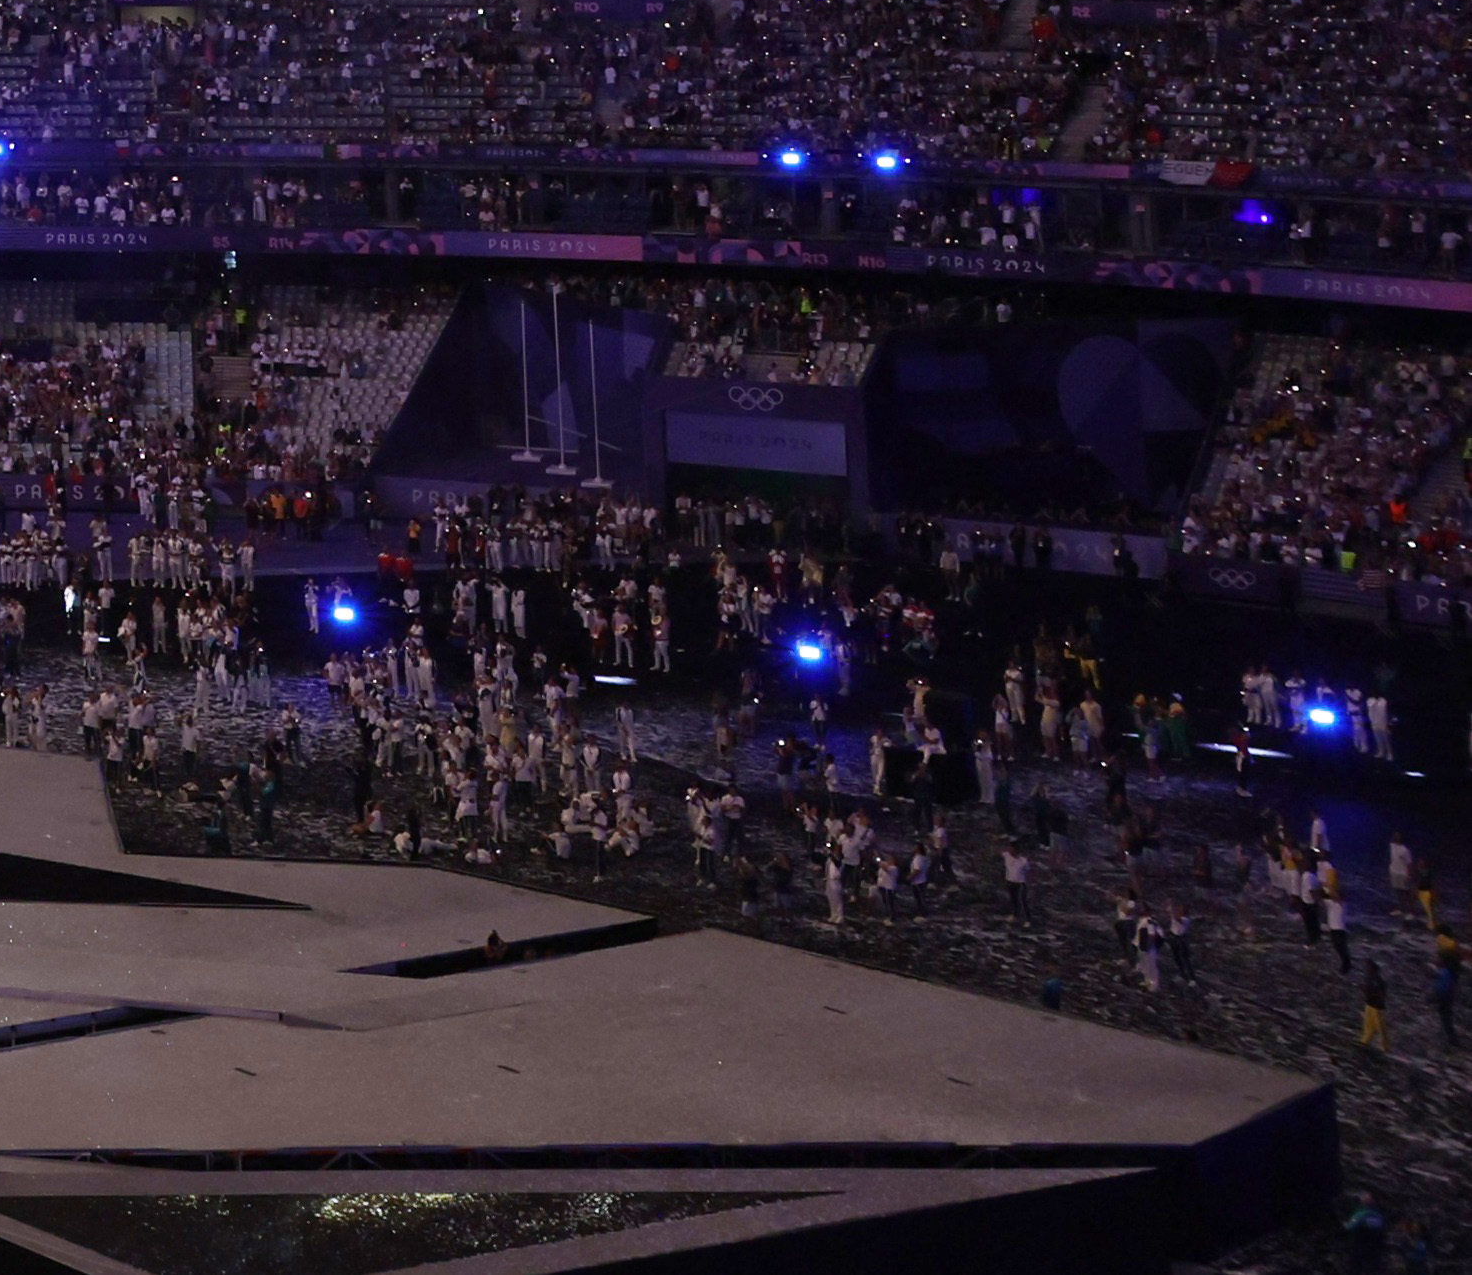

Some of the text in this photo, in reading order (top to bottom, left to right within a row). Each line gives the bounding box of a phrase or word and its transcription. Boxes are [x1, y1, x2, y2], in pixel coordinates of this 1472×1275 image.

[574, 2, 599, 12] R10
[646, 2, 664, 13] R9
[1072, 6, 1091, 18] R2
[46, 232, 148, 245] PARIS 2024
[213, 235, 231, 248] S5
[268, 236, 293, 249] R14
[488, 237, 598, 253] PARIS 2024
[993, 258, 1046, 274] 2024
[1303, 278, 1431, 300] PARIS 2024
[15, 485, 84, 500] PAS
